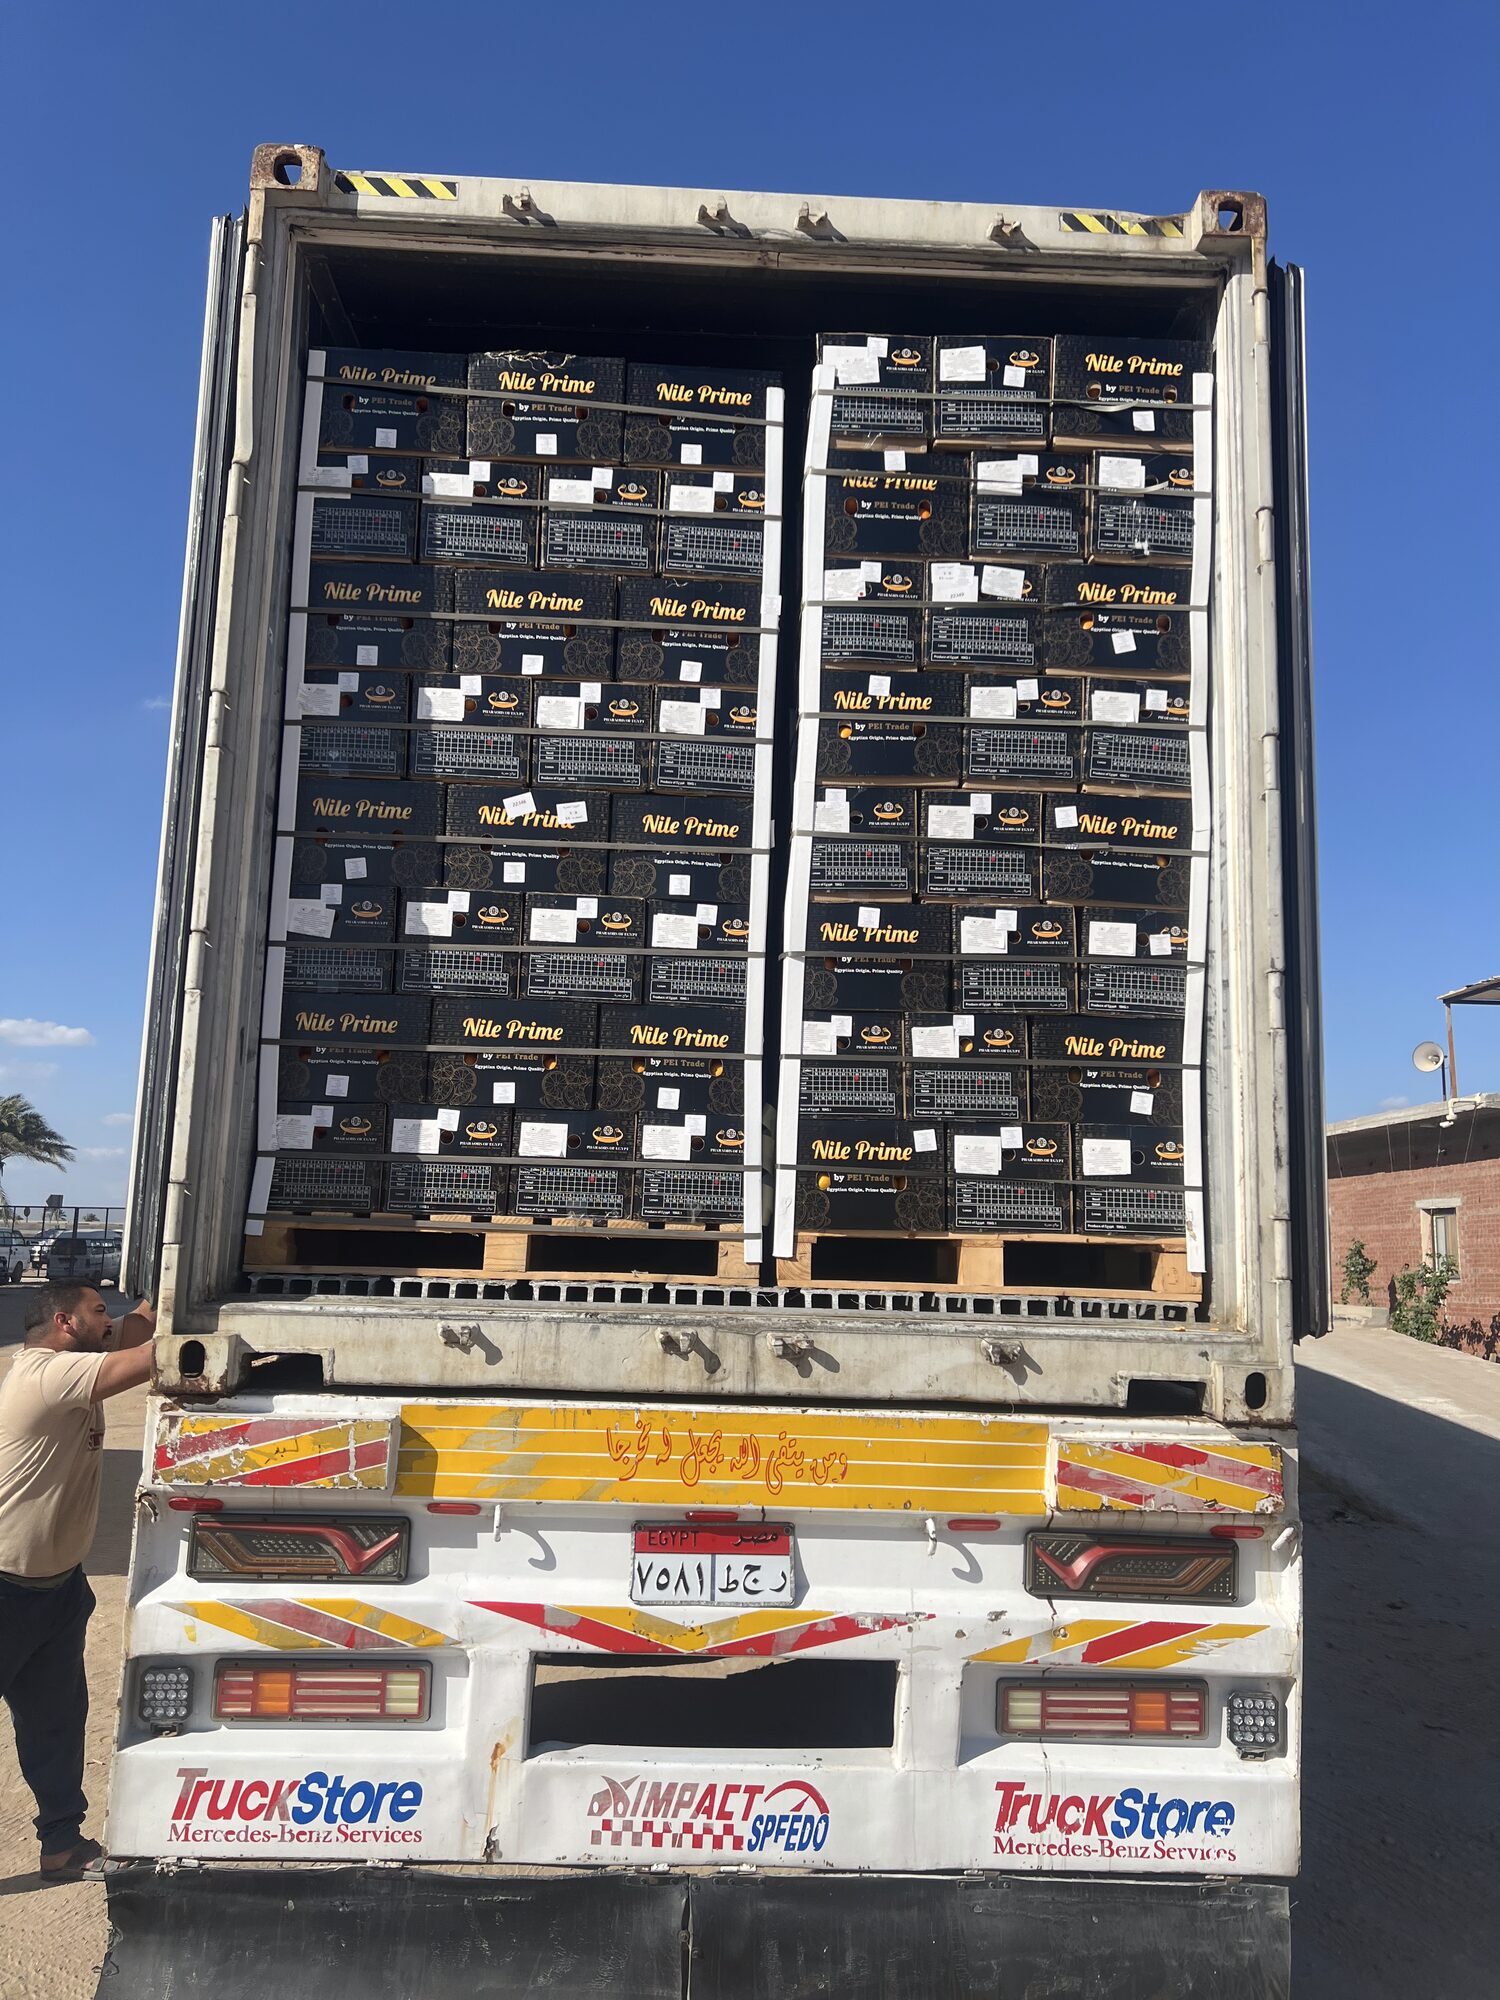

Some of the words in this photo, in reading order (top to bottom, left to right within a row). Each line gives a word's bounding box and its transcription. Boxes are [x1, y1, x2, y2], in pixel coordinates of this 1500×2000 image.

[339, 365, 377, 381] Nile
[381, 367, 436, 386] Prime
[1085, 353, 1123, 373] Nile
[1127, 355, 1183, 377] Prime
[498, 371, 536, 391] Nile
[540, 373, 595, 394] Prime
[1106, 384, 1116, 393] by
[359, 396, 369, 405] by
[656, 383, 693, 402] Nile
[697, 385, 752, 406] Prime
[519, 403, 529, 412] by
[861, 500, 872, 509] by
[324, 582, 361, 600] Nile
[366, 583, 422, 603] Prime
[486, 589, 524, 609] Nile
[528, 591, 584, 612] Prime
[1077, 582, 1117, 602] Nile
[1120, 584, 1177, 605] Prime
[650, 597, 687, 617] Nile
[691, 599, 746, 621] Prime
[1098, 614, 1109, 623] by
[833, 691, 872, 710] Nile
[876, 692, 932, 711] Prime
[855, 722, 865, 732] by
[312, 797, 351, 817] Nile
[355, 799, 412, 820] Prime
[642, 814, 680, 834] Nile
[684, 816, 739, 838] Prime
[1079, 814, 1117, 834] Nile
[1121, 817, 1178, 840] Prime
[820, 922, 859, 942] Nile
[863, 924, 919, 943] Prime
[295, 1012, 335, 1032] Nile
[340, 1013, 398, 1033] Prime
[463, 1017, 502, 1038] Nile
[506, 1019, 564, 1041] Prime
[630, 1025, 669, 1046] Nile
[673, 1027, 729, 1048] Prime
[1064, 1036, 1104, 1057] Nile
[1108, 1038, 1166, 1059] Prime
[650, 1058, 661, 1067] by
[1087, 1070, 1098, 1078] by
[812, 1140, 851, 1160] Nile
[855, 1140, 913, 1161] Prime
[834, 1174, 844, 1182] by
[680, 1429, 724, 1487] يجعل
[730, 1434, 760, 1479] الله
[648, 1530, 699, 1547] EGYPT
[731, 1531, 778, 1547] مصر
[636, 1561, 704, 1596] ٧٥٨١
[171, 1767, 423, 1825] TruckStore
[630, 1781, 765, 1821] IMPACT
[167, 1823, 333, 1843] Mercedes-Benz
[336, 1824, 423, 1843] Services
[992, 1836, 1150, 1859] Mercedes-Benz
[1153, 1839, 1237, 1861] Services
